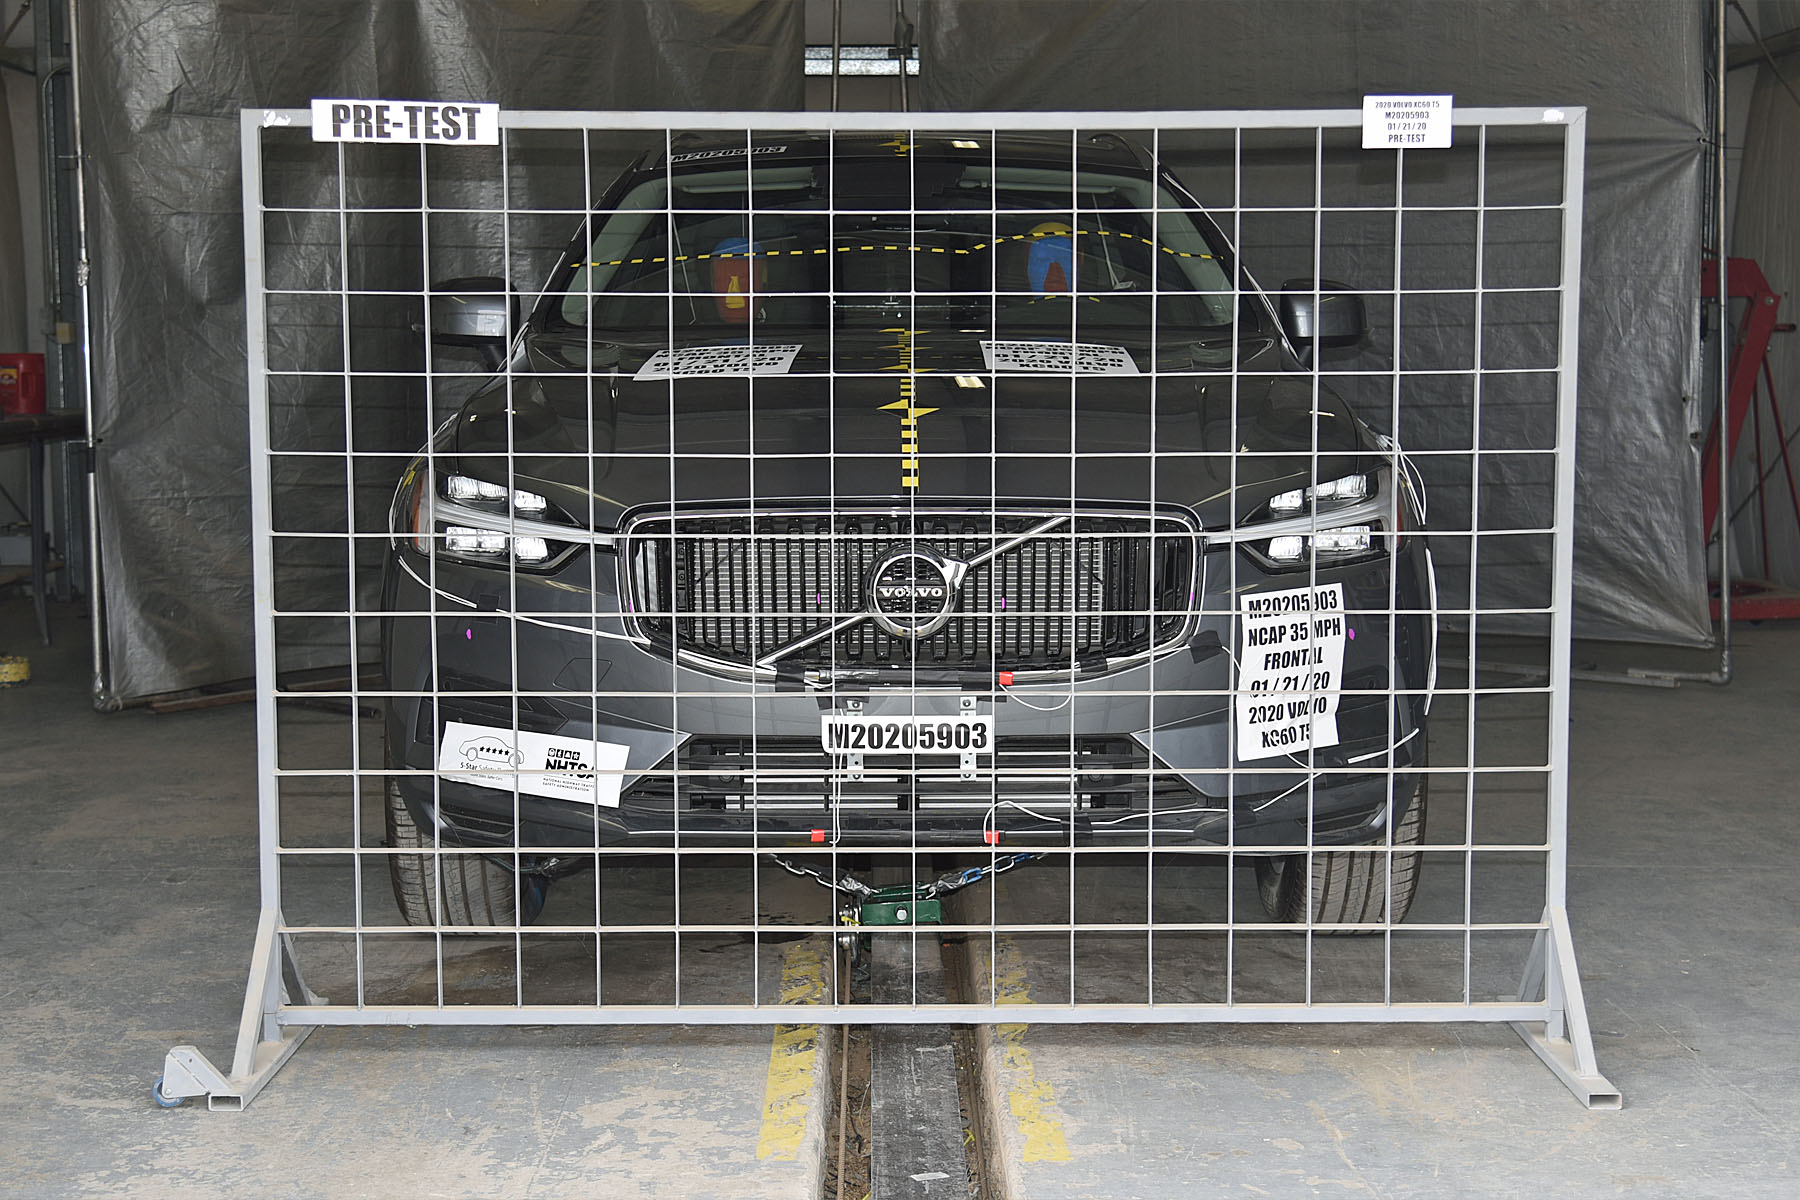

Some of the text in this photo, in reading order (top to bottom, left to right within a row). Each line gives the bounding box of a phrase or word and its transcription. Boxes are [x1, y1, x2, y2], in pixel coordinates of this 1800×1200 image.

[332, 104, 481, 140] PRE-TEST
[1385, 111, 1429, 119] M20205903
[1389, 134, 1425, 142] PRE-TEST
[1248, 617, 1341, 647] NCAP 35 MPH
[1248, 703, 1284, 725] 2020
[828, 722, 988, 750] M20205903
